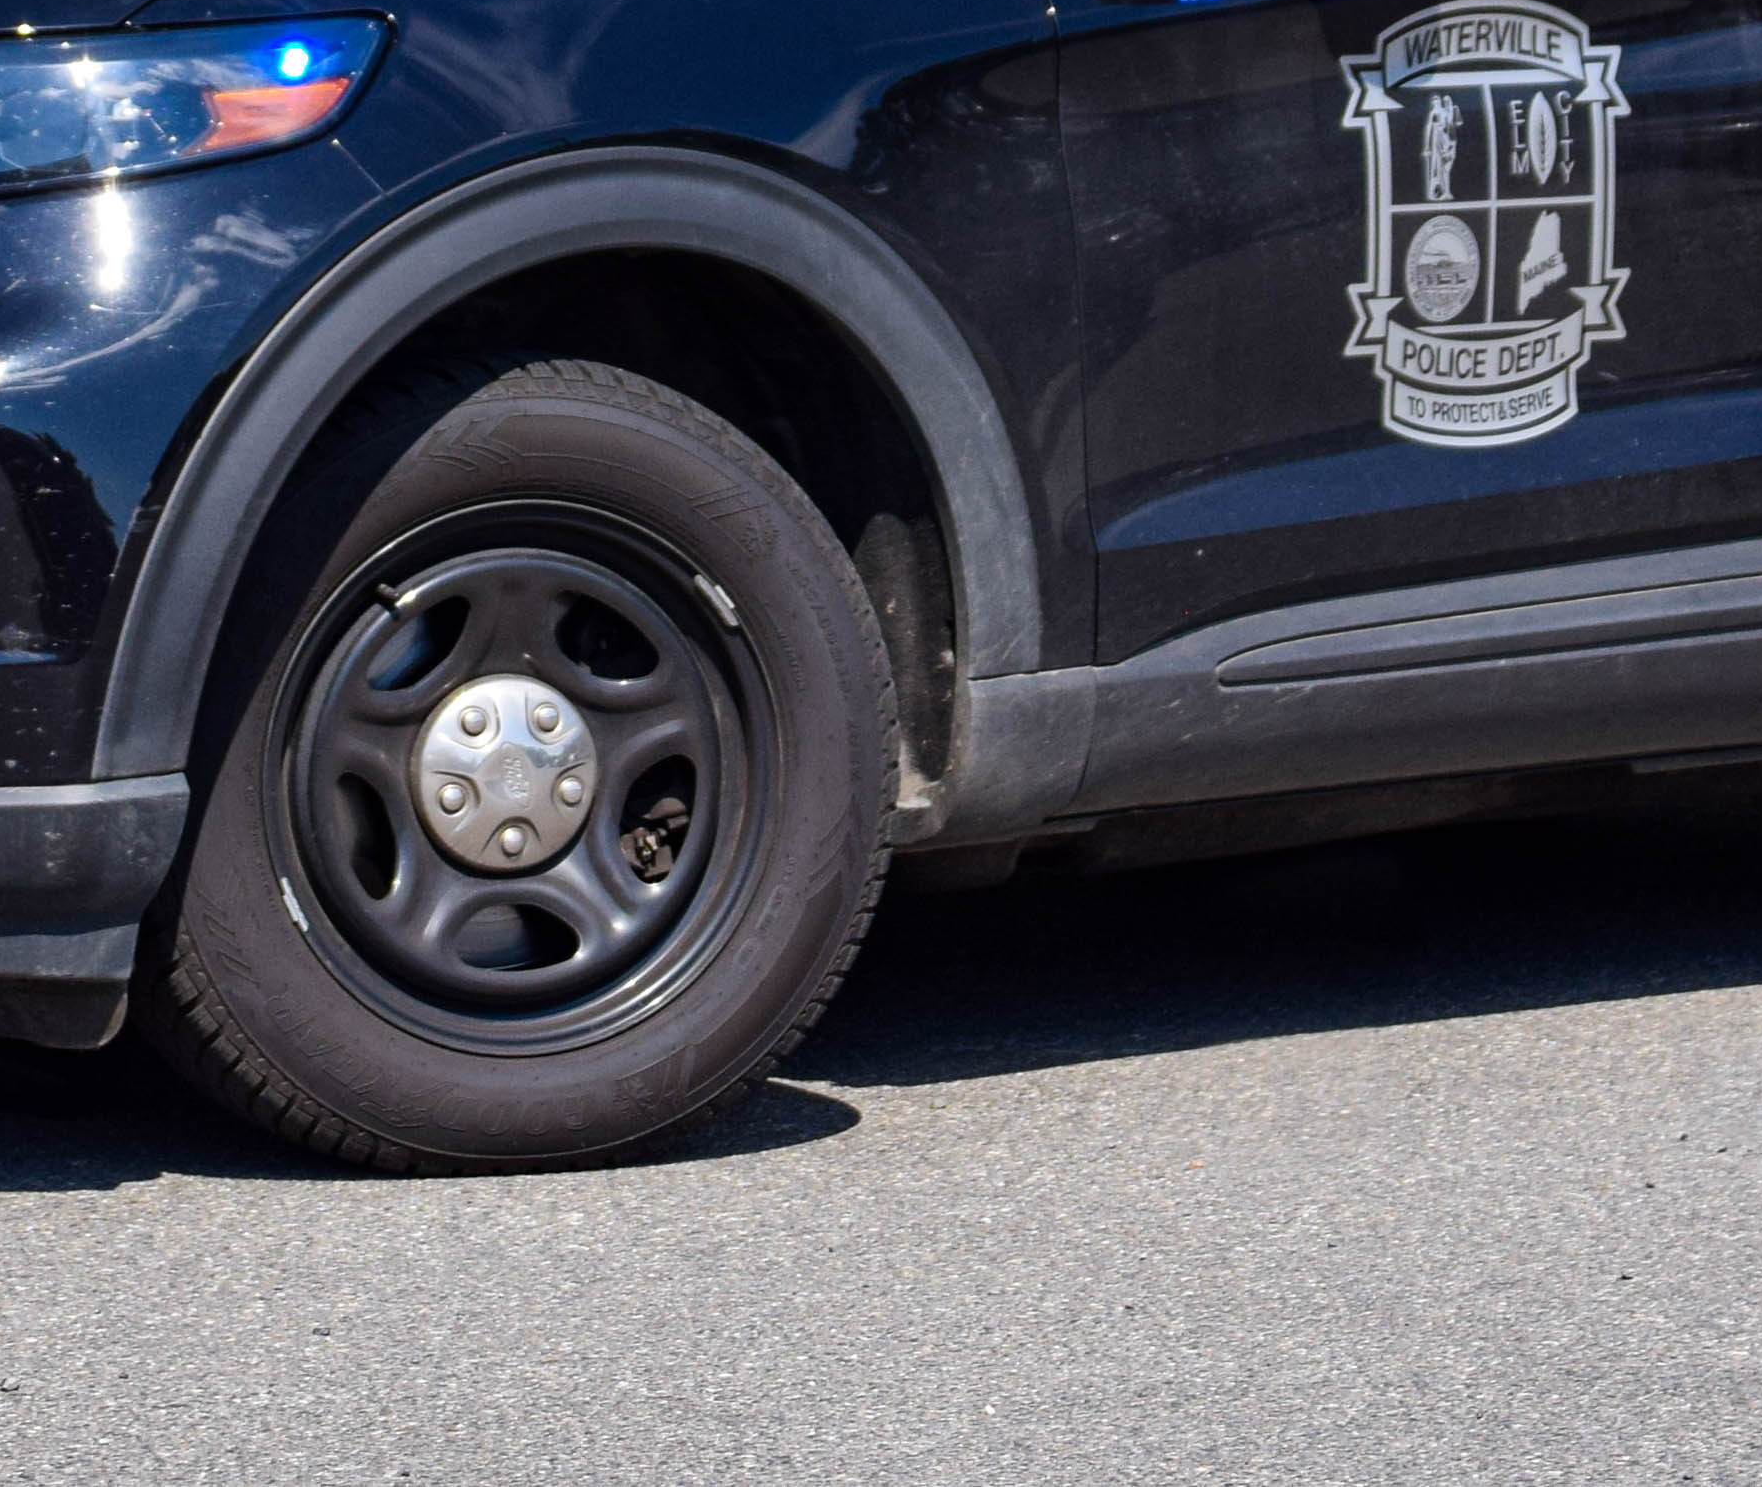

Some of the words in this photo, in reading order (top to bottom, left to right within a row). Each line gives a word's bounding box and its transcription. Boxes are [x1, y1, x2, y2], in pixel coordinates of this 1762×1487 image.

[1404, 18, 1563, 67] WATERVILLE
[1509, 100, 1530, 174] ELM
[1555, 90, 1575, 184] CITY
[1523, 253, 1559, 284] MAINE
[1402, 339, 1487, 379] POLICE
[1498, 331, 1565, 376] DEPT.
[1408, 395, 1426, 418] TO
